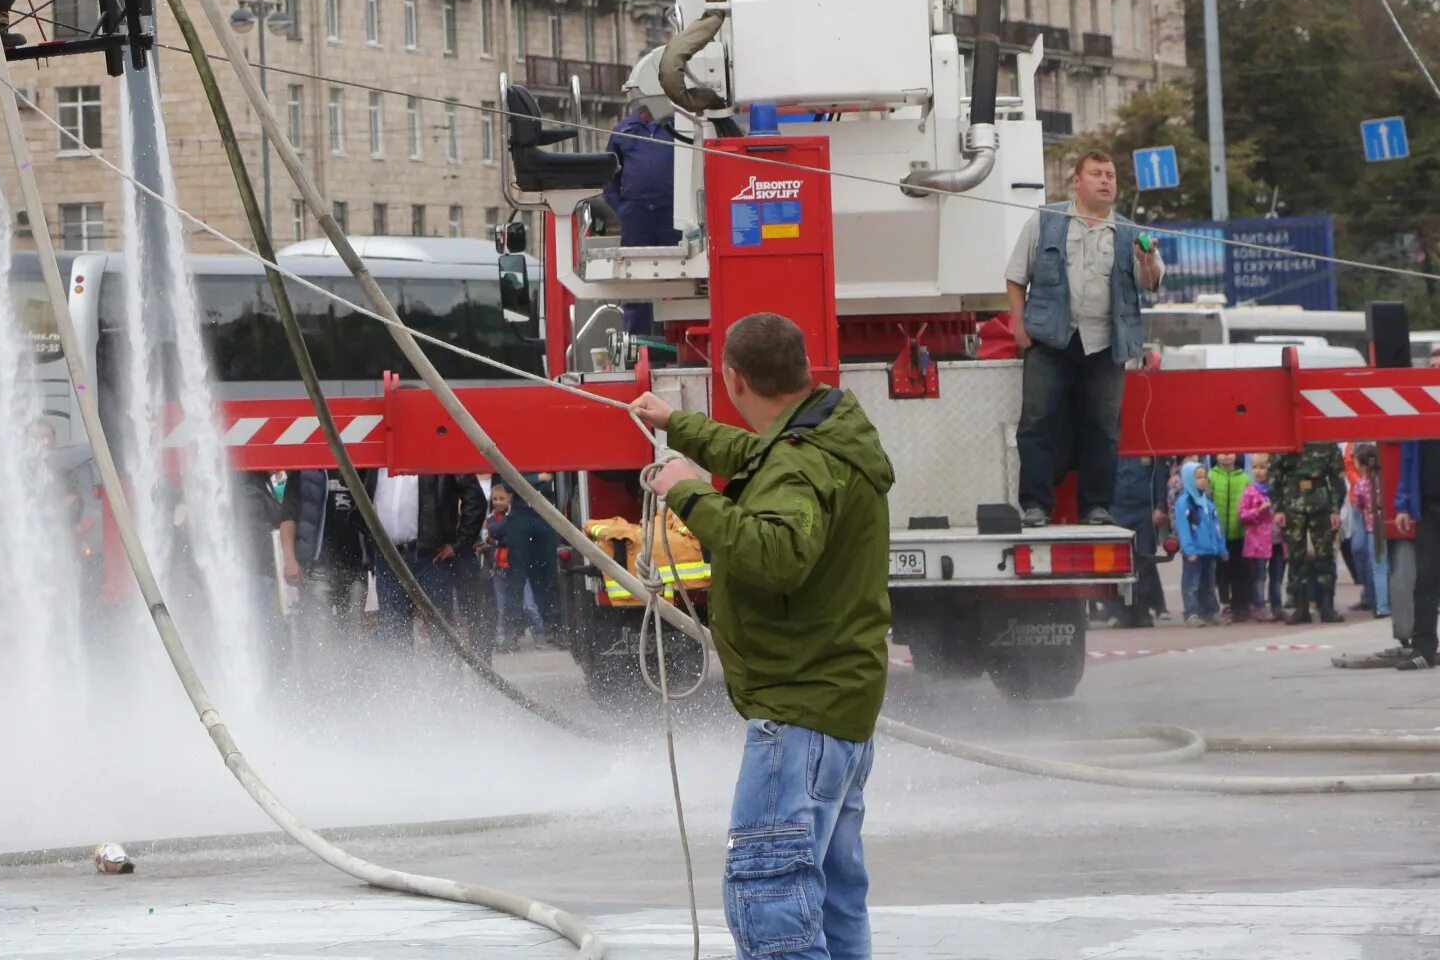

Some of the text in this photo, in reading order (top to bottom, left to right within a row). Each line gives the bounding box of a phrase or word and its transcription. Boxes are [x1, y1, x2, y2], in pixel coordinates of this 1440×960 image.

[755, 180, 801, 191] BRONTO
[755, 189, 800, 200] SKYLIFT
[898, 554, 917, 568] 98
